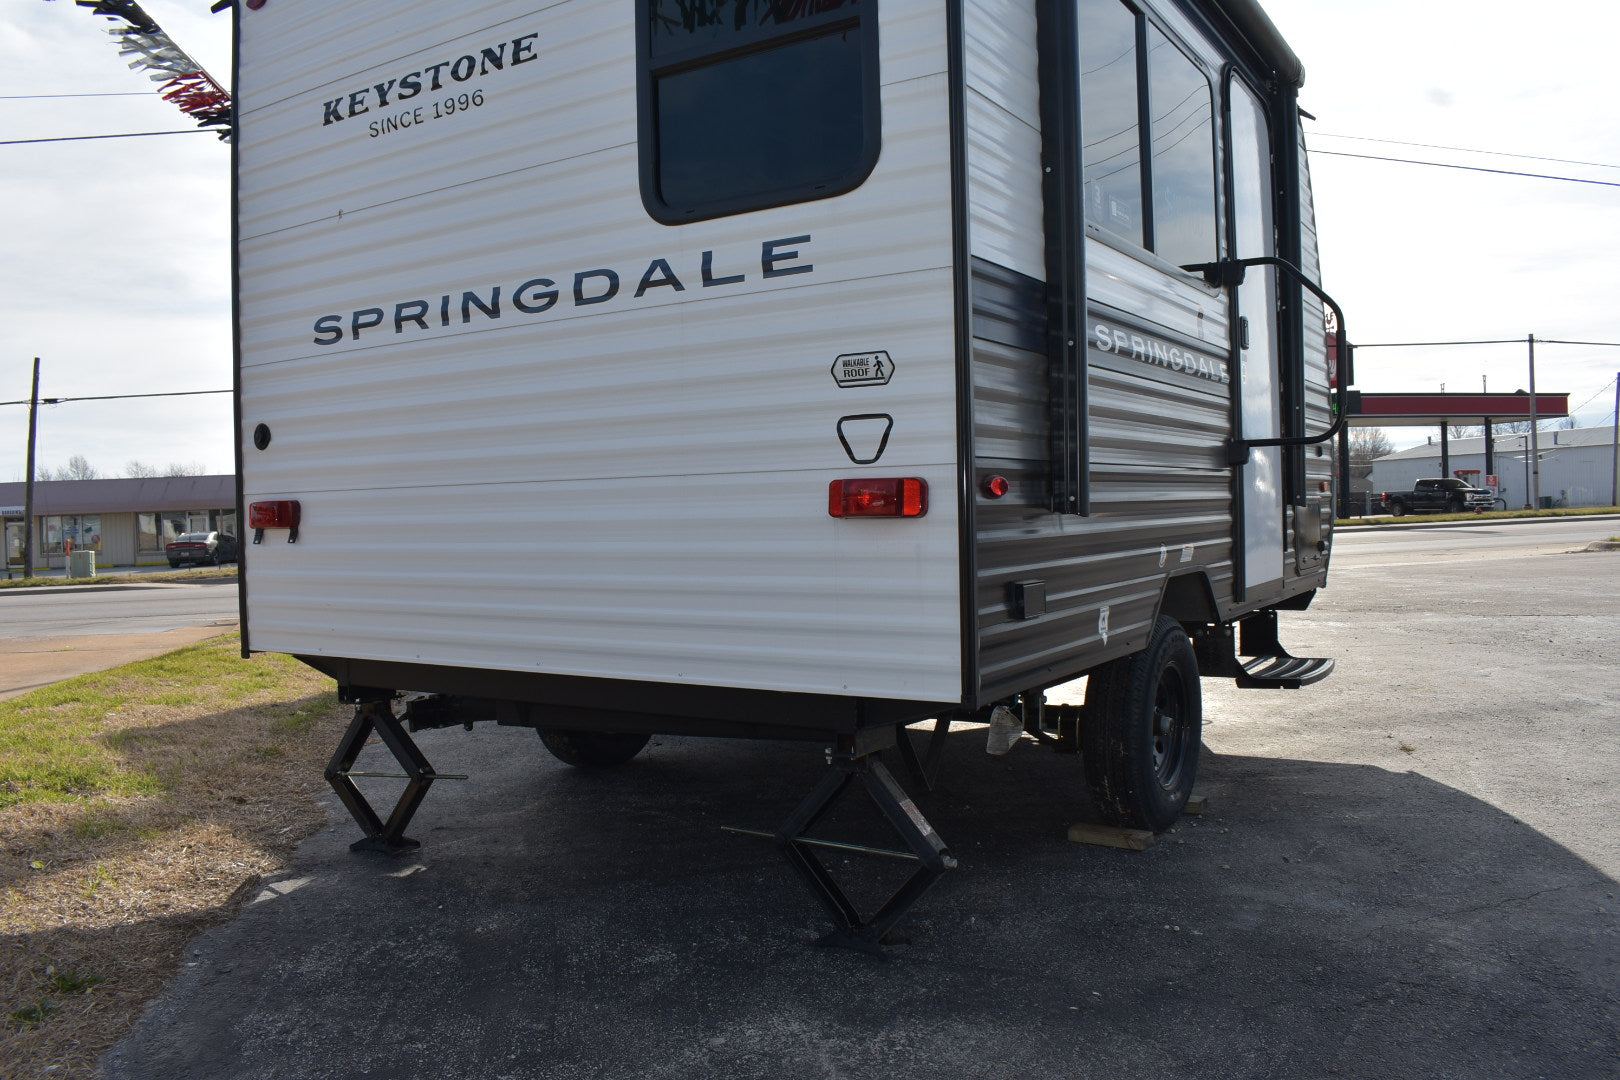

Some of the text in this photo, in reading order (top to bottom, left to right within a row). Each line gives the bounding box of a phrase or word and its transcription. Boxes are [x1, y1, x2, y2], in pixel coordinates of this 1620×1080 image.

[322, 32, 539, 127] KEYSTONE
[368, 88, 484, 138] SINCE 1996
[313, 234, 814, 346] SPRINGDALE
[842, 358, 870, 368] WALKABLE
[843, 368, 870, 378] ROOF
[1094, 324, 1230, 384] SPRINGDALE
